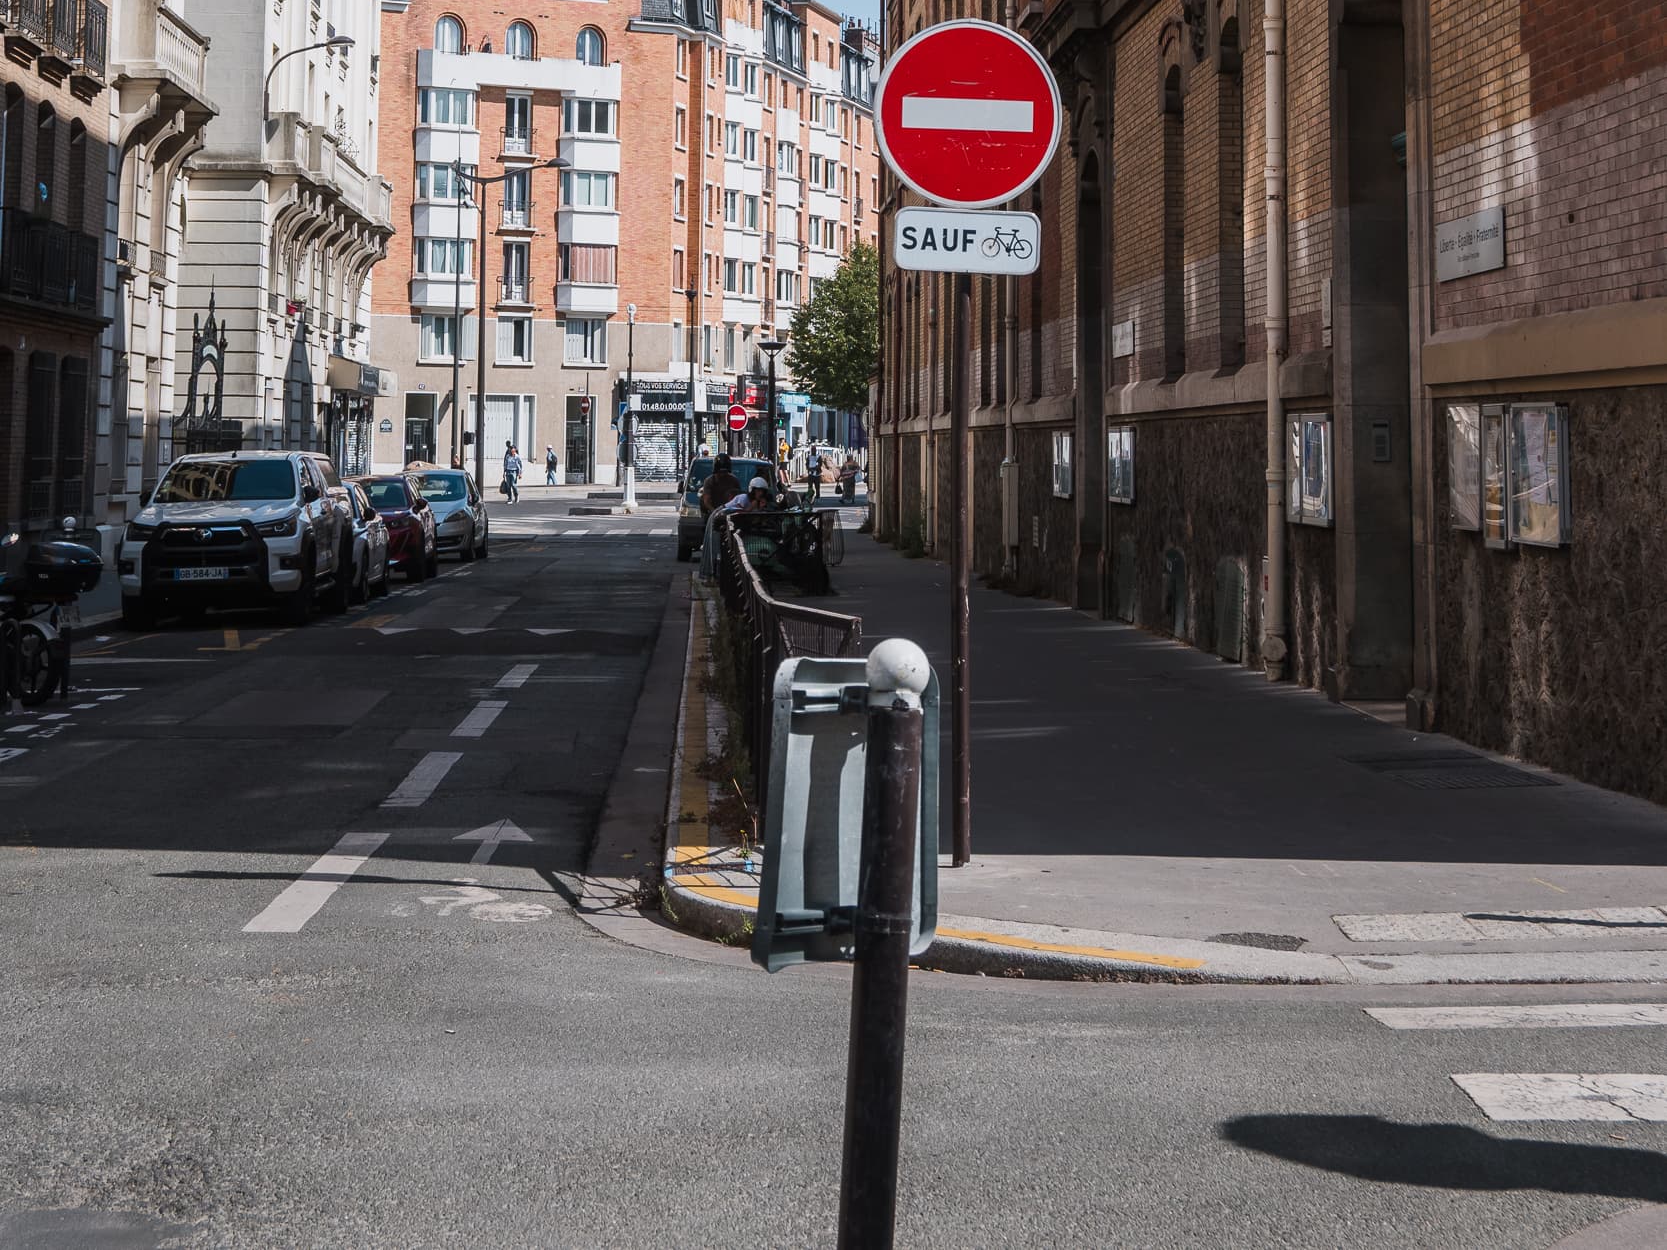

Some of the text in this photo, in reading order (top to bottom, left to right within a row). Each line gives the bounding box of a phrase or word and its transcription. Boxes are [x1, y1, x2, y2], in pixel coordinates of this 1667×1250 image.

[901, 225, 977, 253] SAUF
[1476, 222, 1499, 242] Fraternité
[663, 382, 688, 390] SERVICES
